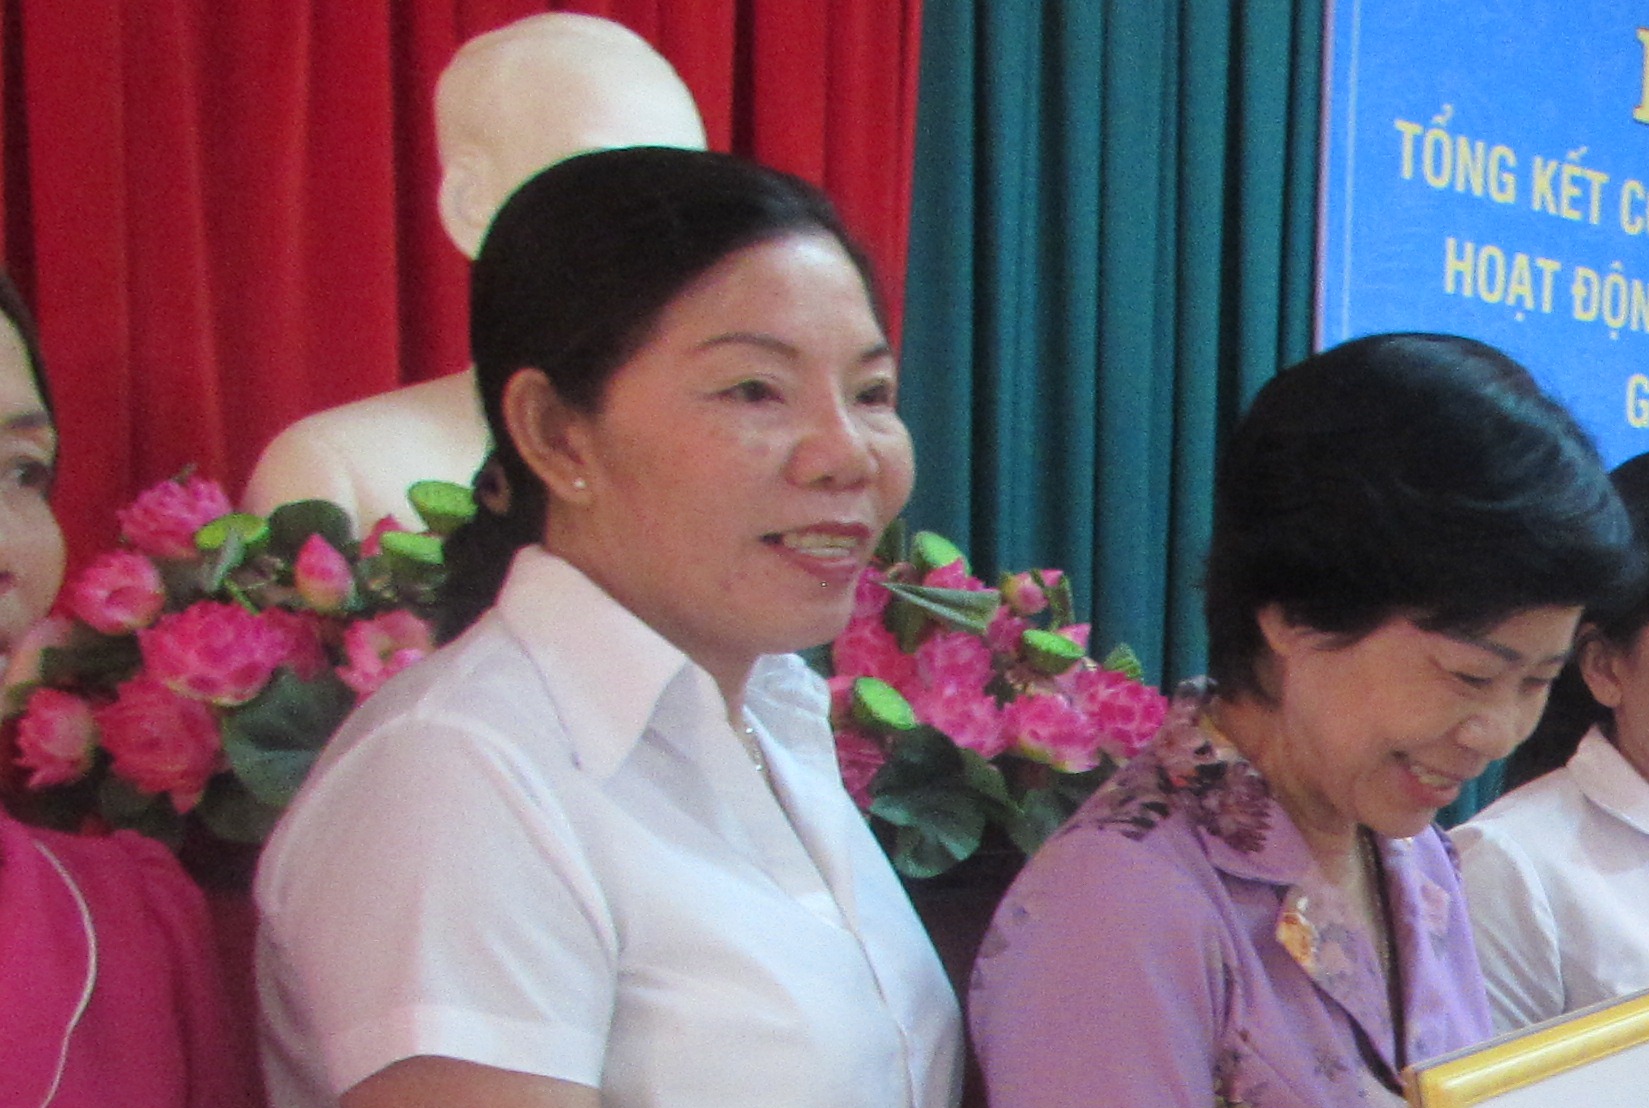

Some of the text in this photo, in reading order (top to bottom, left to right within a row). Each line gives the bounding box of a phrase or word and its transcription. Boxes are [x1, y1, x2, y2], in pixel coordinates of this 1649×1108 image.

[1394, 103, 1518, 204] TỔNG
[1532, 145, 1610, 225] KẾT
[1444, 236, 1562, 323] HOẠT
